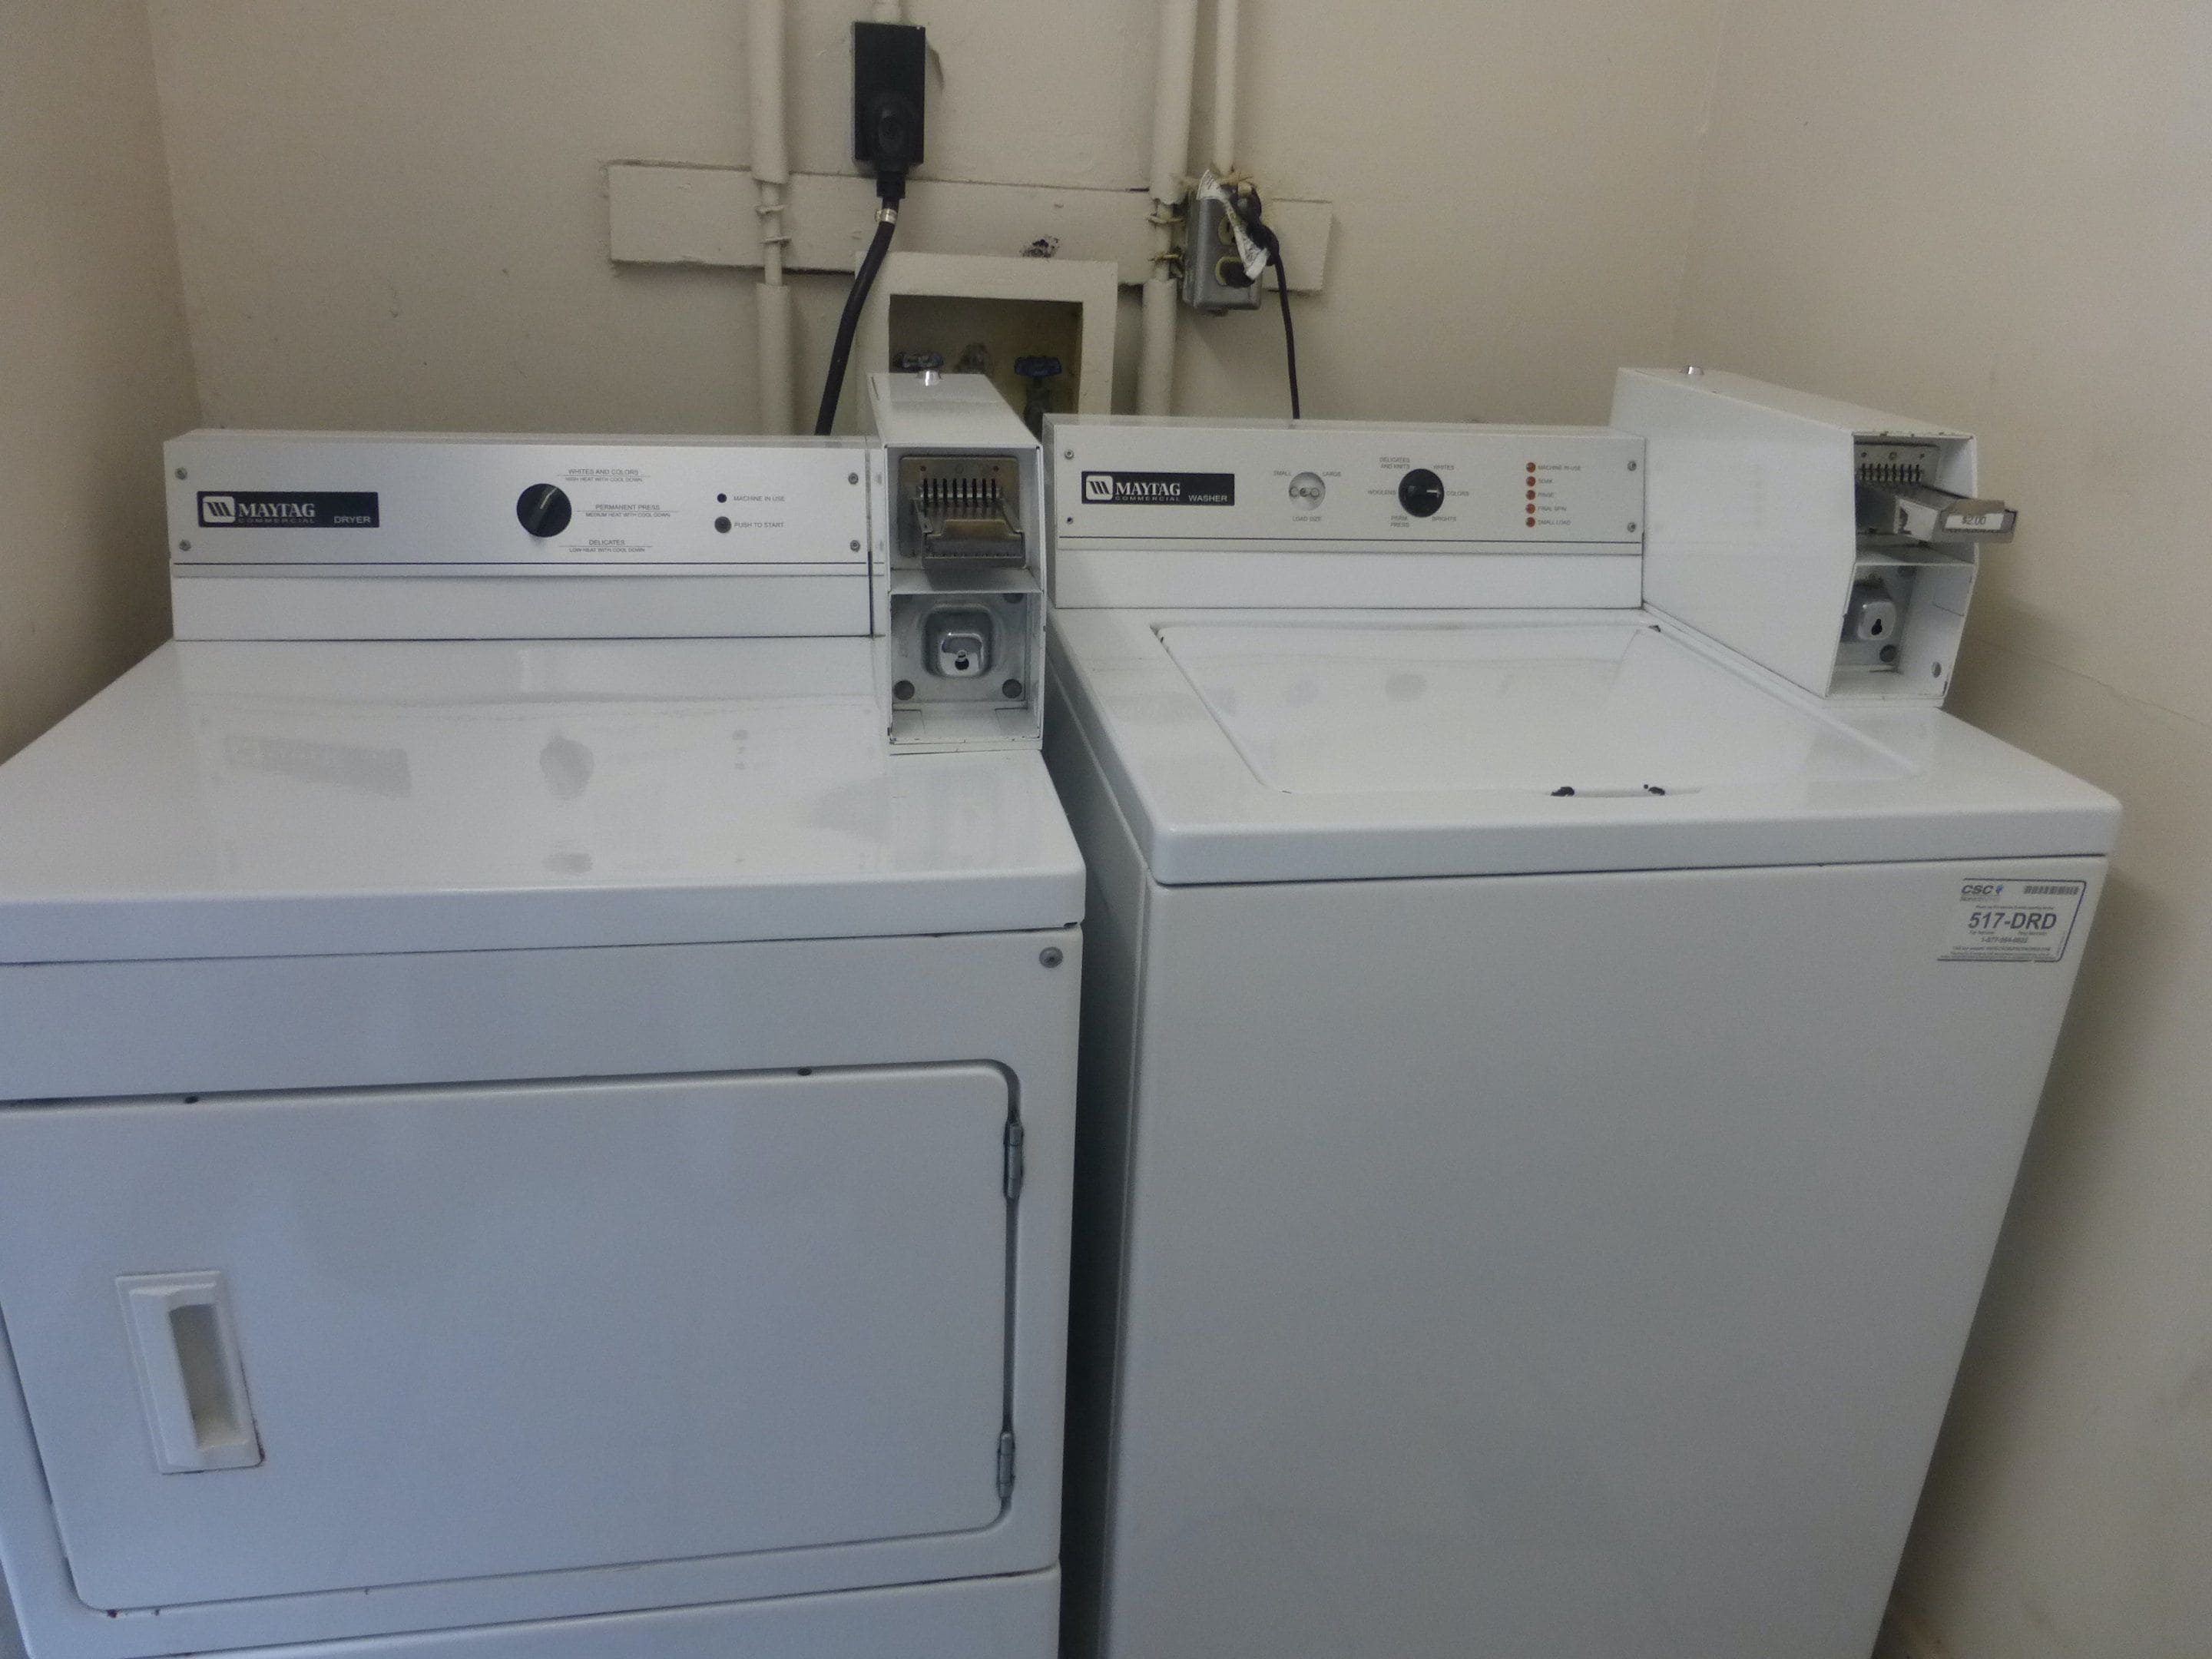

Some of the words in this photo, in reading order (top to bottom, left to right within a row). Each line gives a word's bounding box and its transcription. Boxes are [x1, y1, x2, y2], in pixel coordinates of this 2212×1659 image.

[1115, 482, 1181, 495] MAYTAG
[238, 503, 316, 518] MAYTAG
[333, 515, 371, 524] DRYER
[1961, 885, 1994, 895] CSC
[1968, 912, 2057, 930] 517-DRD
